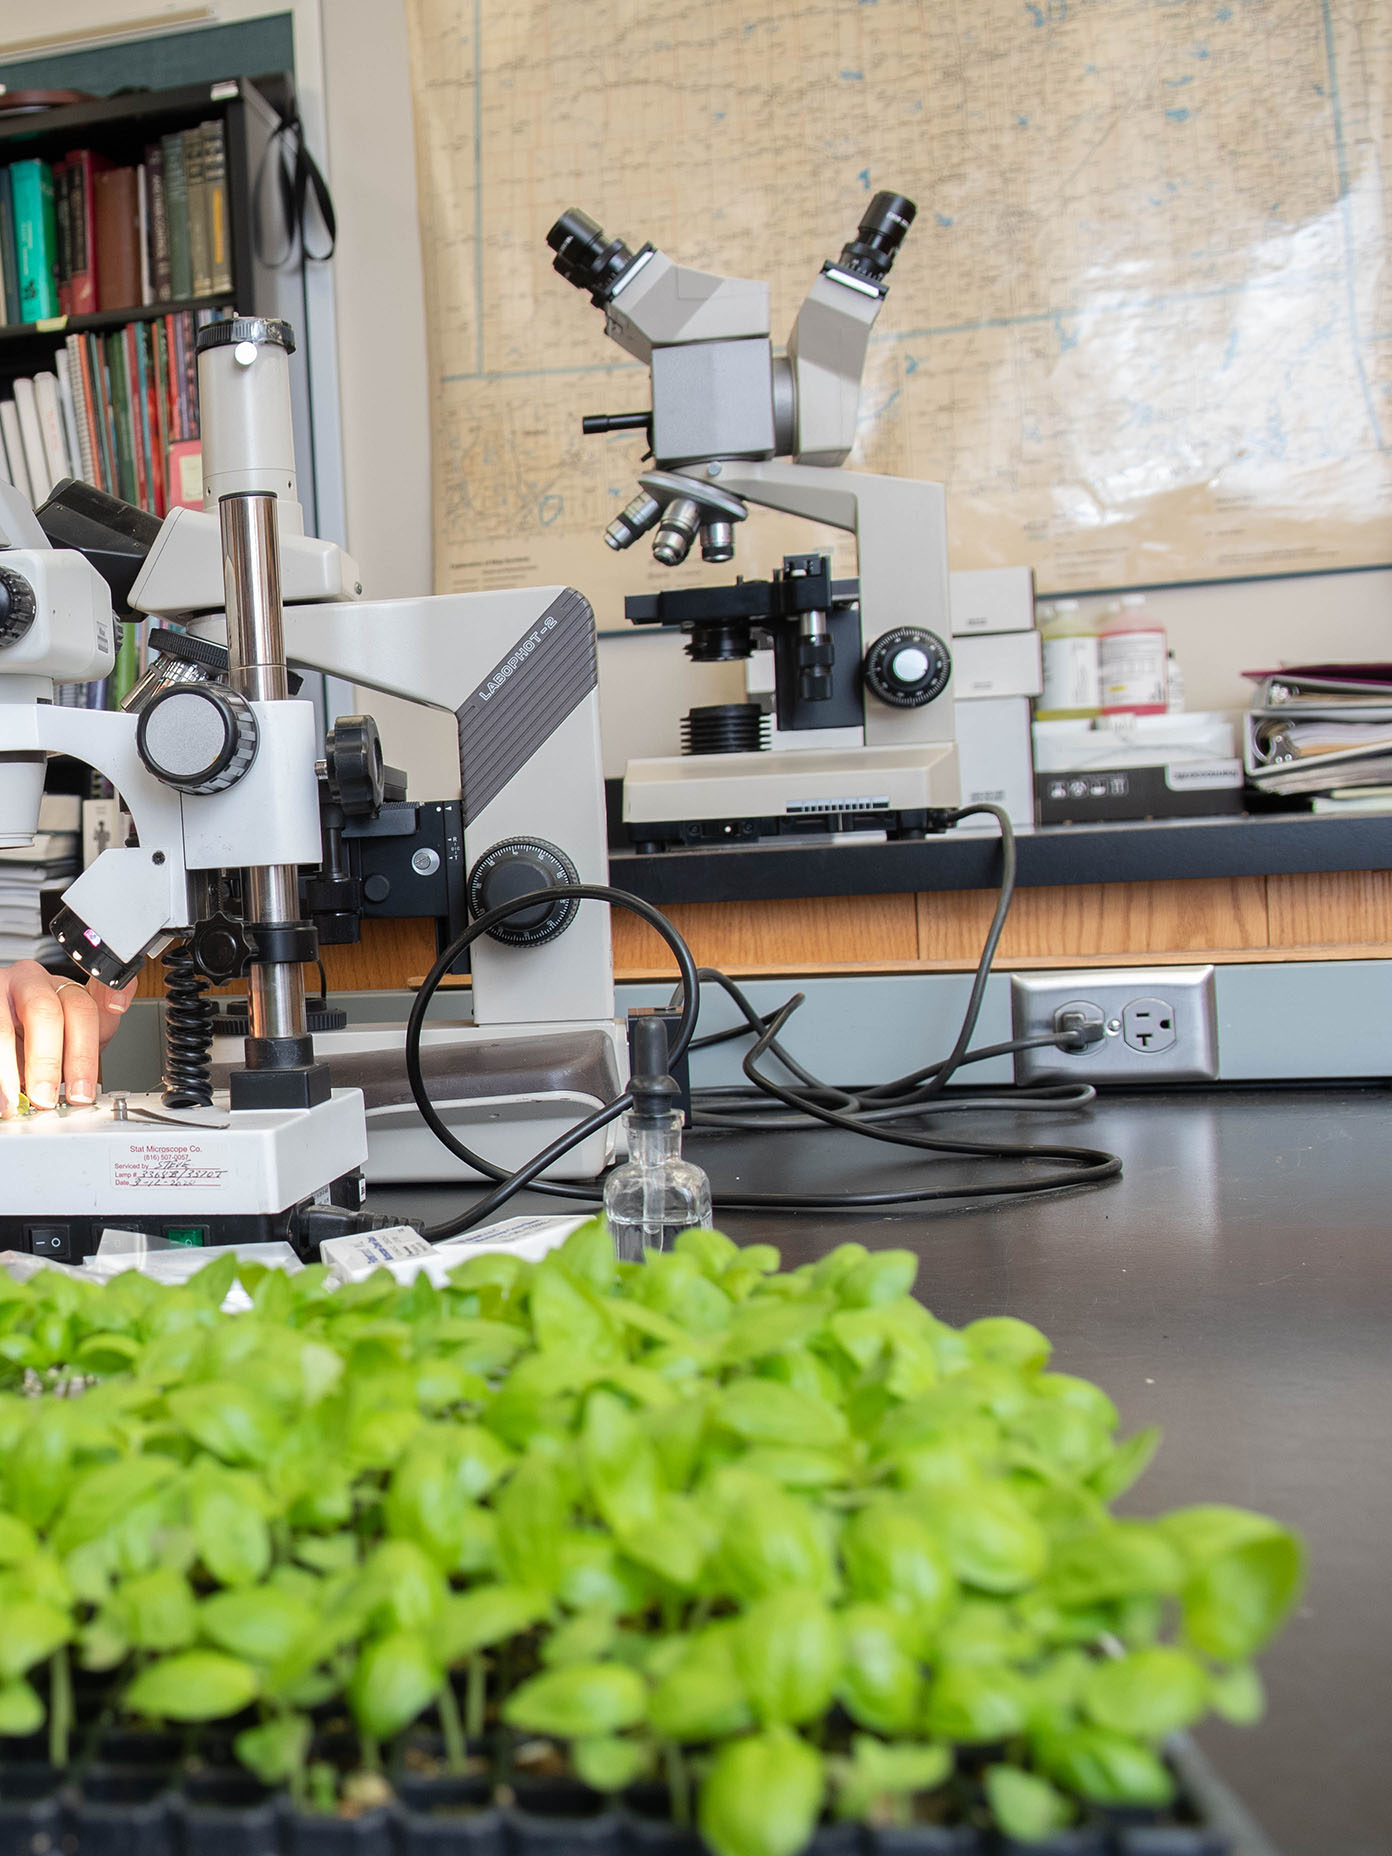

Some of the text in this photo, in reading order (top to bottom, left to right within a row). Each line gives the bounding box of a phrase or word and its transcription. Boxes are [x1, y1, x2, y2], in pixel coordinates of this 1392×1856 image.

[478, 616, 558, 701] LABOPHOT-2
[129, 1145, 202, 1154] Stat Microscope Co.
[141, 1163, 149, 1171] by
[154, 1159, 192, 1170] STEVE
